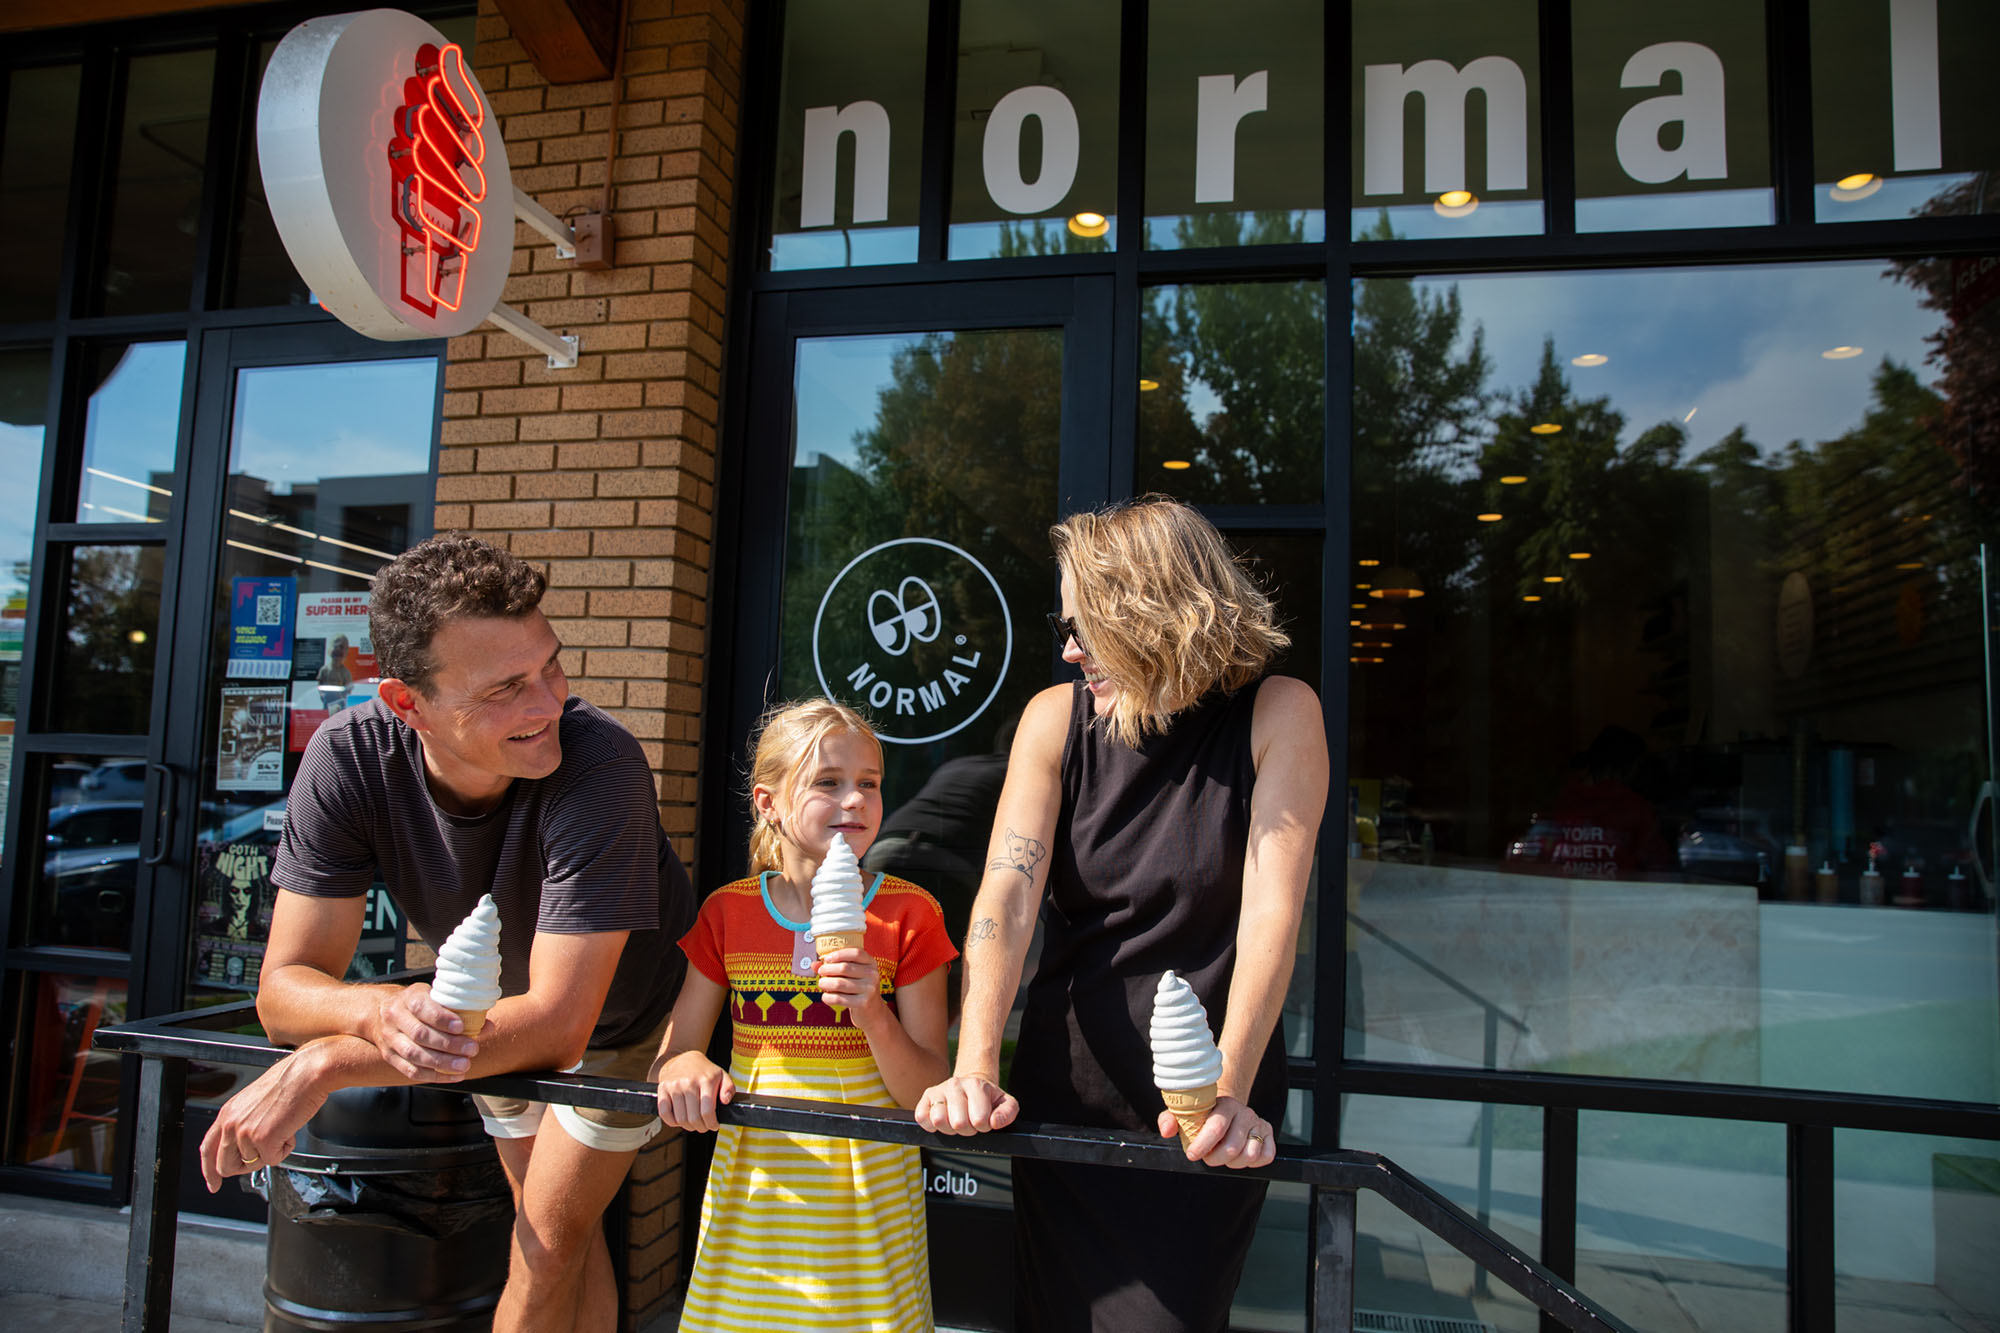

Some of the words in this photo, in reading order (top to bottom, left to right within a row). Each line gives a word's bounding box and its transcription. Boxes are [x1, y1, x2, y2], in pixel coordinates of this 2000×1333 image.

[799, 0, 1943, 229] normal
[306, 605, 342, 616] SUPER
[345, 605, 369, 615] HER
[846, 651, 981, 716] NORMAL
[264, 699, 282, 711] ART
[248, 712, 282, 725] STUDIO
[229, 844, 258, 857] GOTH
[216, 853, 269, 880] NIGHT
